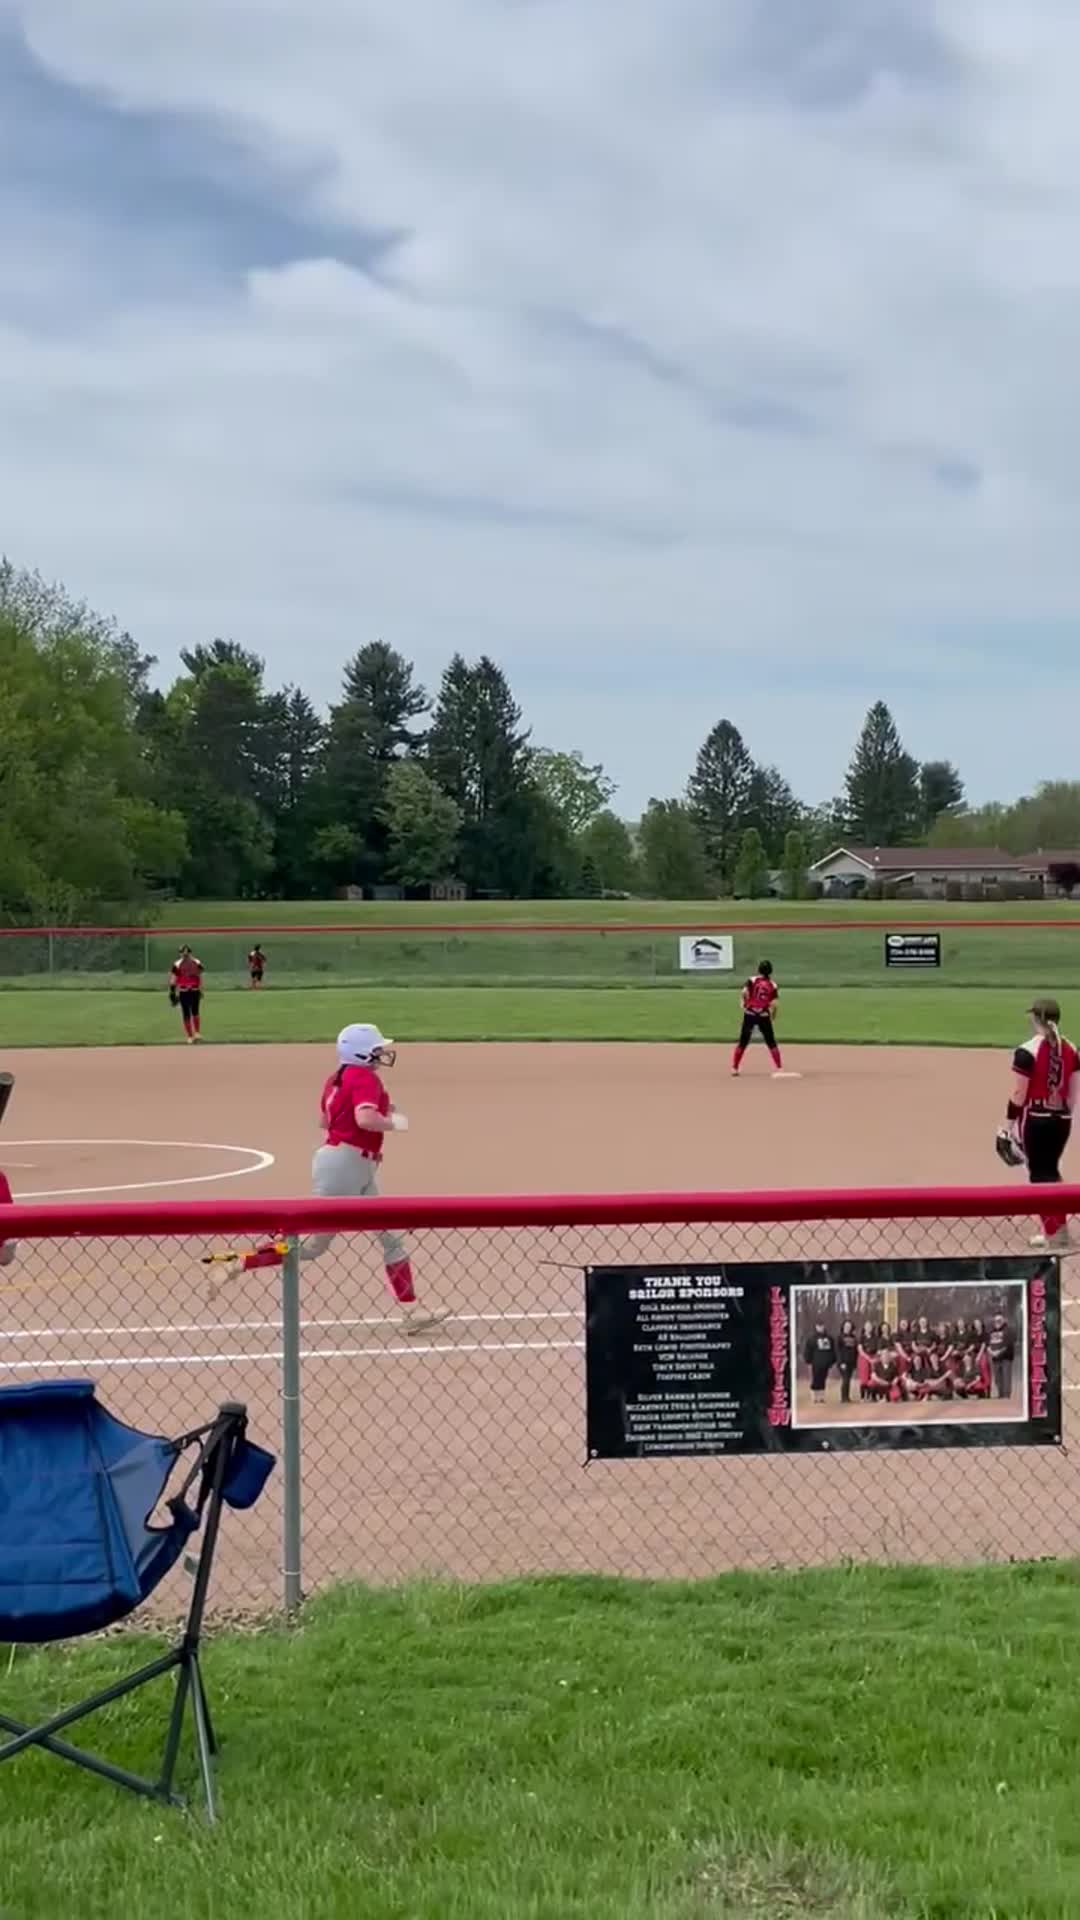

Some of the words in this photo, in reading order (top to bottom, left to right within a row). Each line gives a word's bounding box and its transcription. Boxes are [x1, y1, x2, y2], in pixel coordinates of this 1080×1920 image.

[629, 1289, 676, 1300] SAILOR
[679, 1287, 744, 1298] SPONSORS
[644, 1277, 692, 1287] THANK
[695, 1276, 722, 1286] YOU
[768, 1286, 790, 1426] LAKEVIEW
[1031, 1278, 1049, 1418] SOFTBALL
